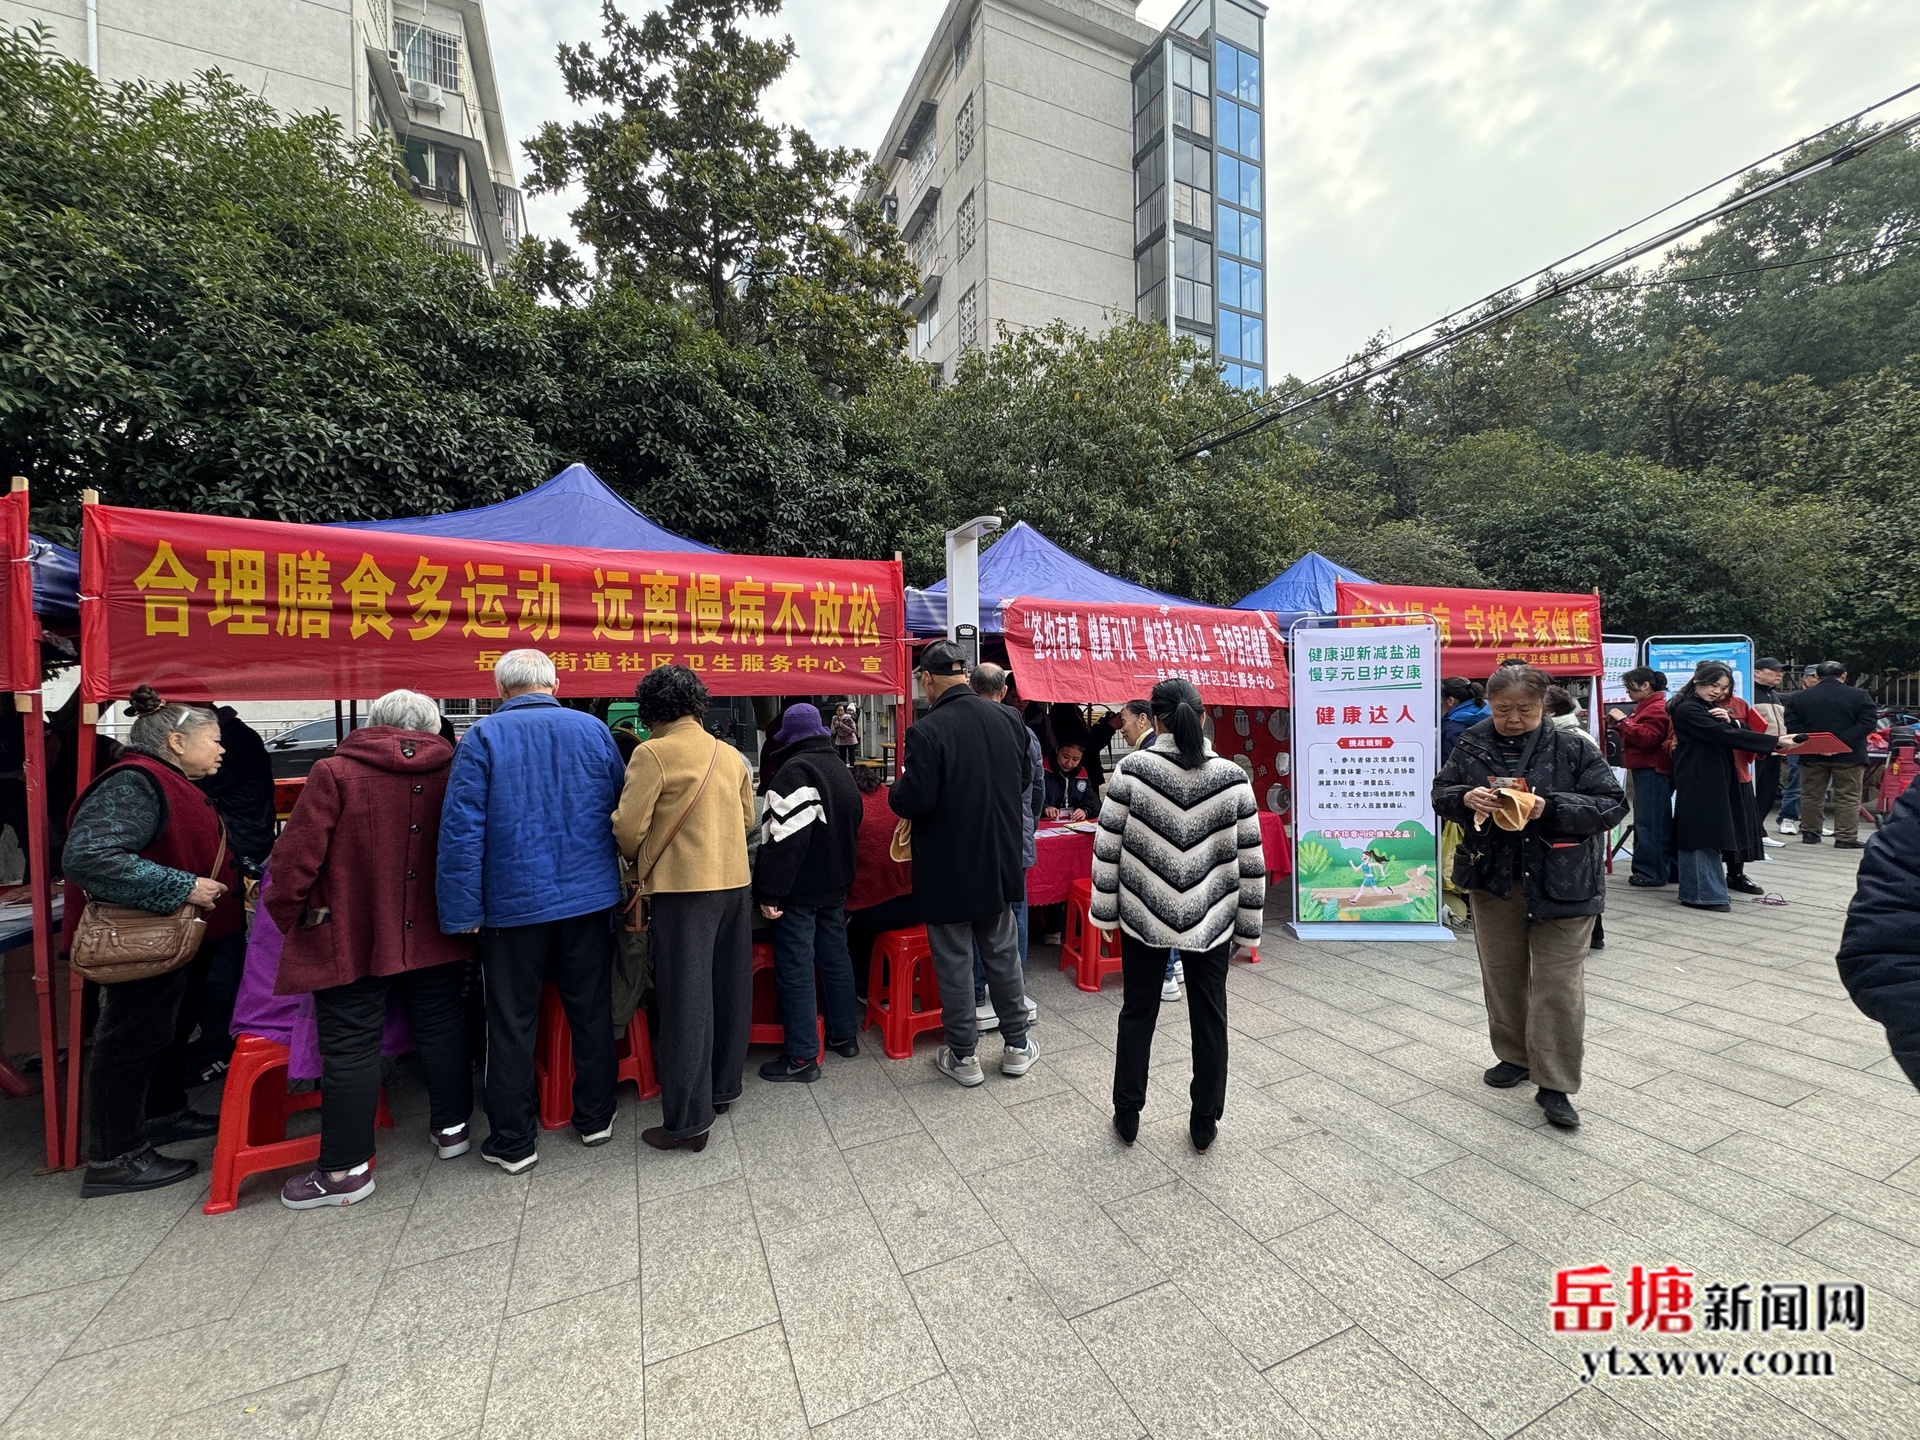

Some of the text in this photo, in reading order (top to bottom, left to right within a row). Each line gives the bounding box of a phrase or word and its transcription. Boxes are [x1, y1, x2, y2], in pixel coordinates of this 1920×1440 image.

[134, 540, 882, 647] 合理膳食多运动 远离慢病不放松
[1463, 604, 1592, 649] 守护全家健康
[474, 650, 882, 673] 岳街道社区卫生服务中心 宣
[1308, 644, 1421, 662] 健康迎新减盐油
[1584, 653, 1594, 664] 宣
[1308, 664, 1421, 682] 慢享元旦护安康
[1315, 704, 1416, 725] 健康达人
[1348, 739, 1383, 748] 挑战规则
